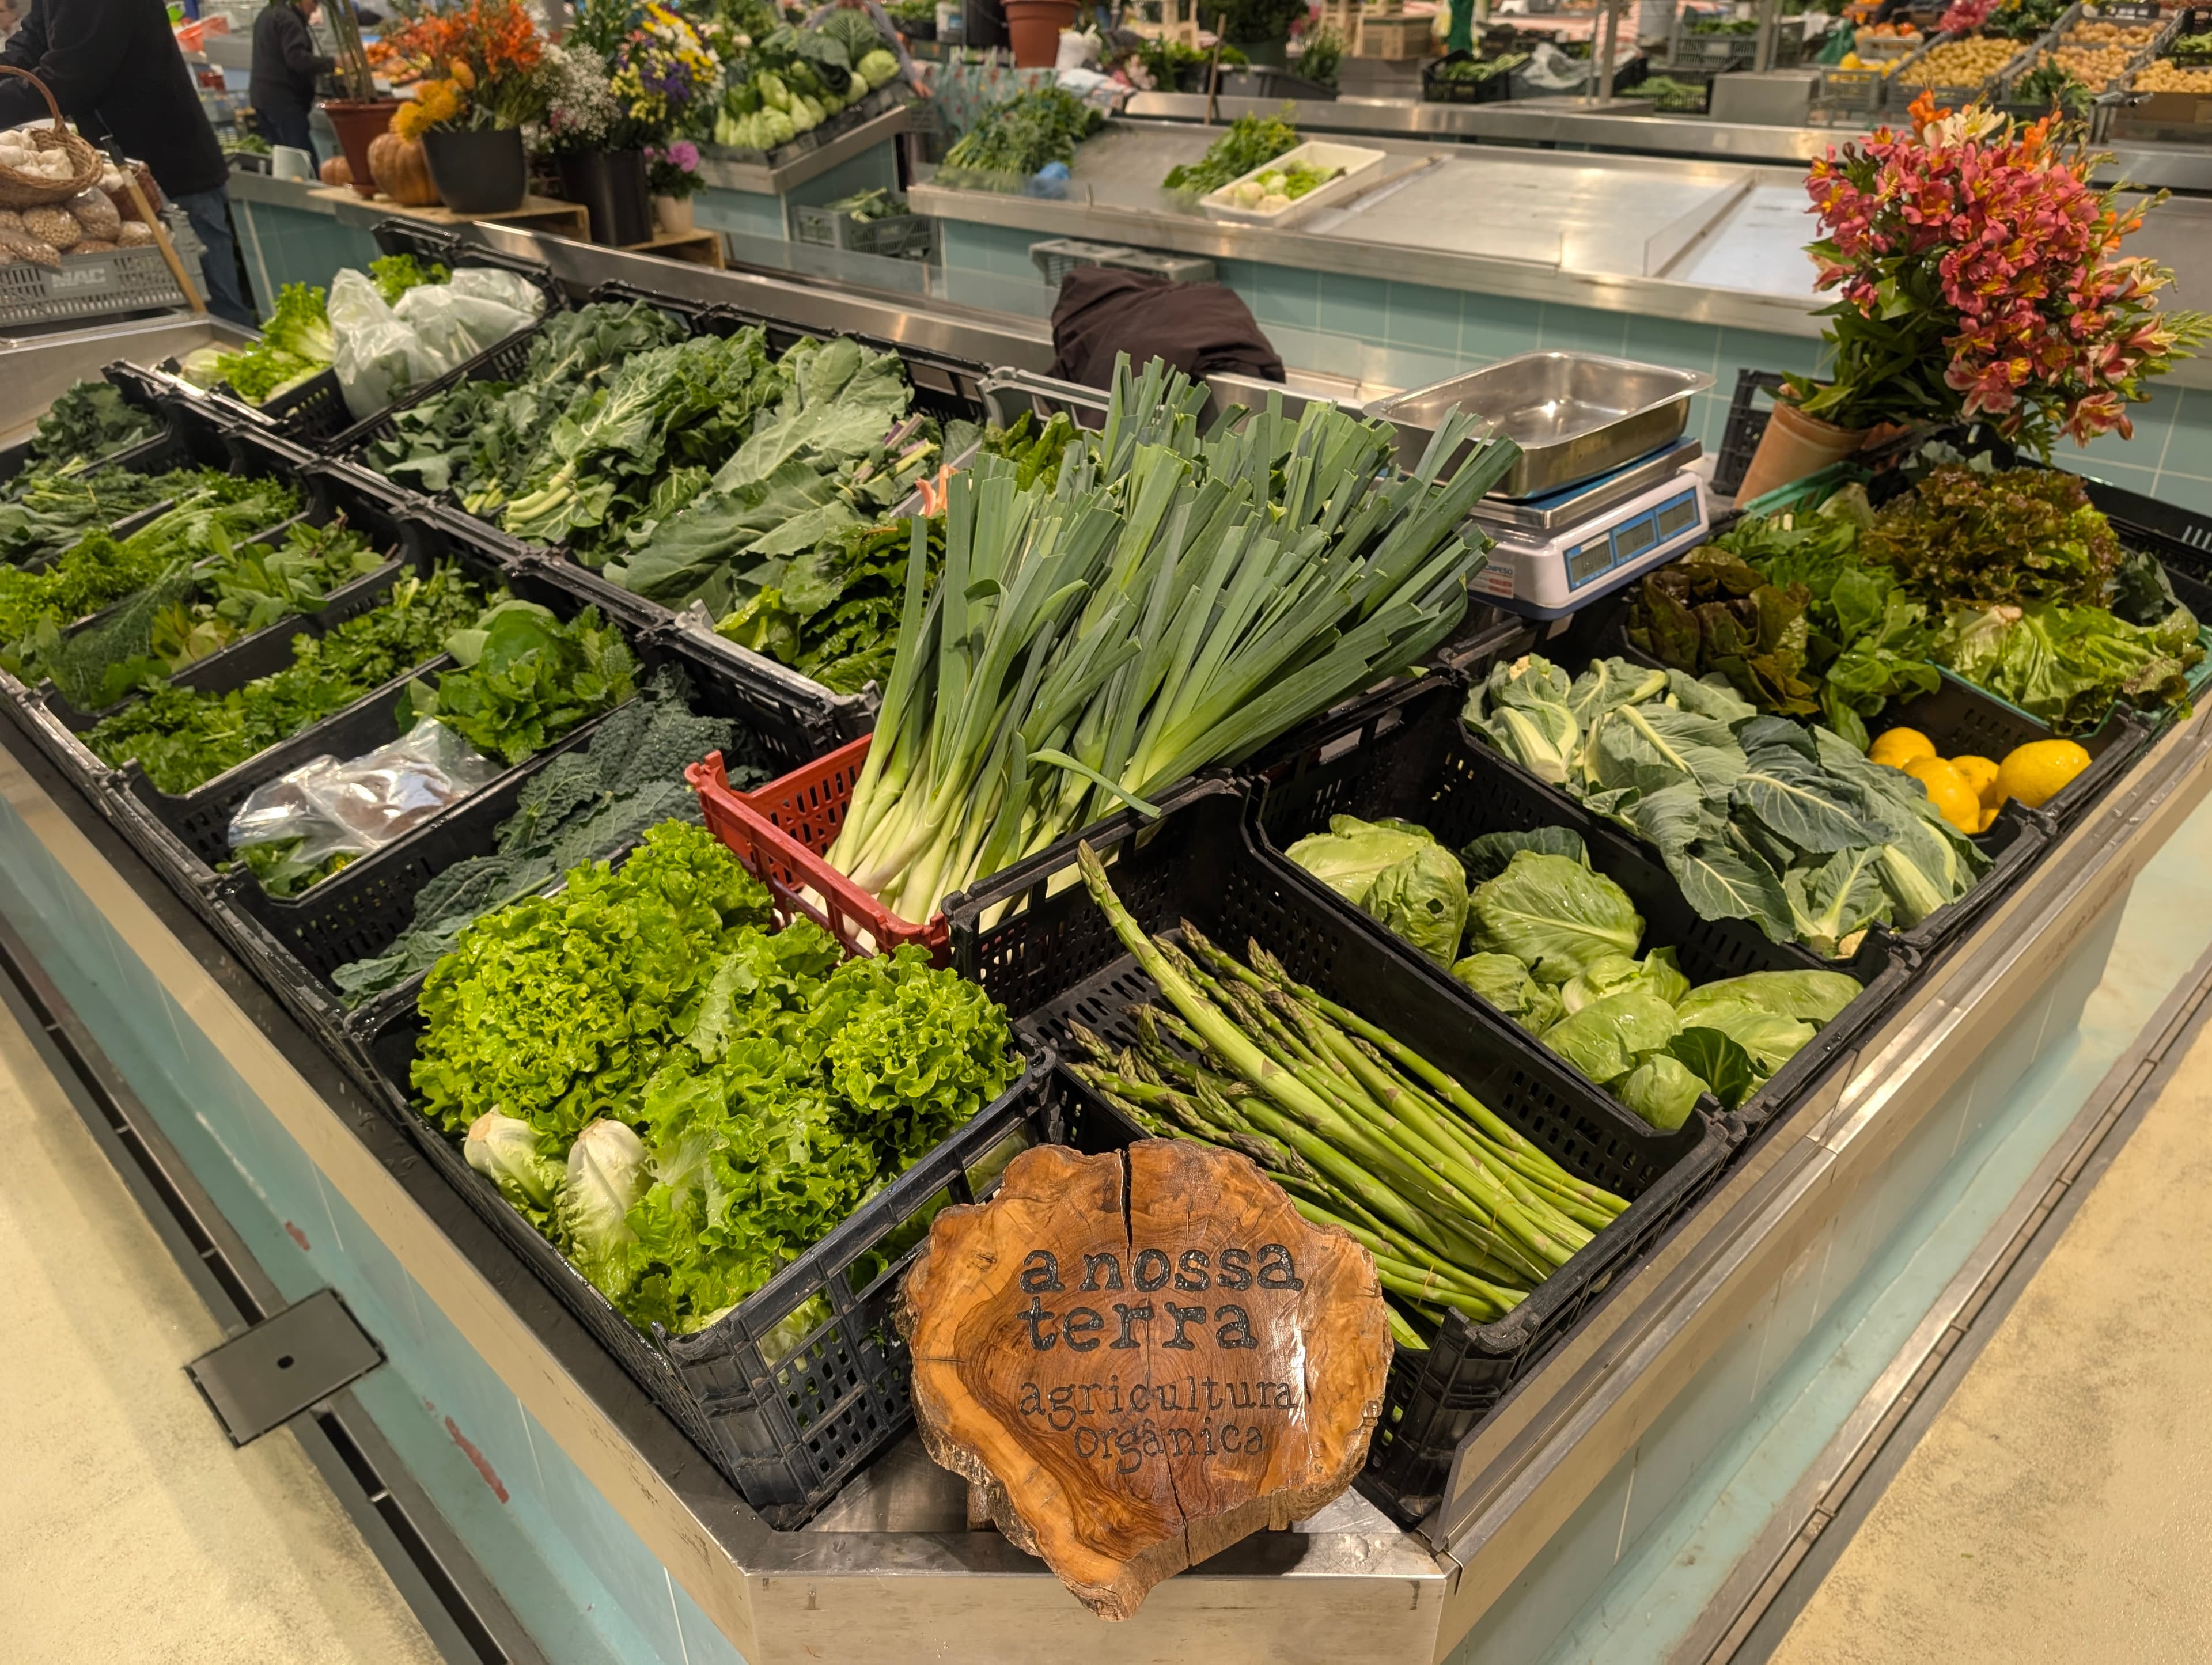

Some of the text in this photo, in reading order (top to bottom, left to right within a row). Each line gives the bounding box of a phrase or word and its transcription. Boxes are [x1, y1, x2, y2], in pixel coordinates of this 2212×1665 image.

[51, 268, 107, 288] MAC
[1020, 1243, 1304, 1294] a nossa
[1015, 1296, 1258, 1351] terra
[1018, 1374, 1299, 1432] agricultura
[1074, 1416, 1267, 1474] orgânica
